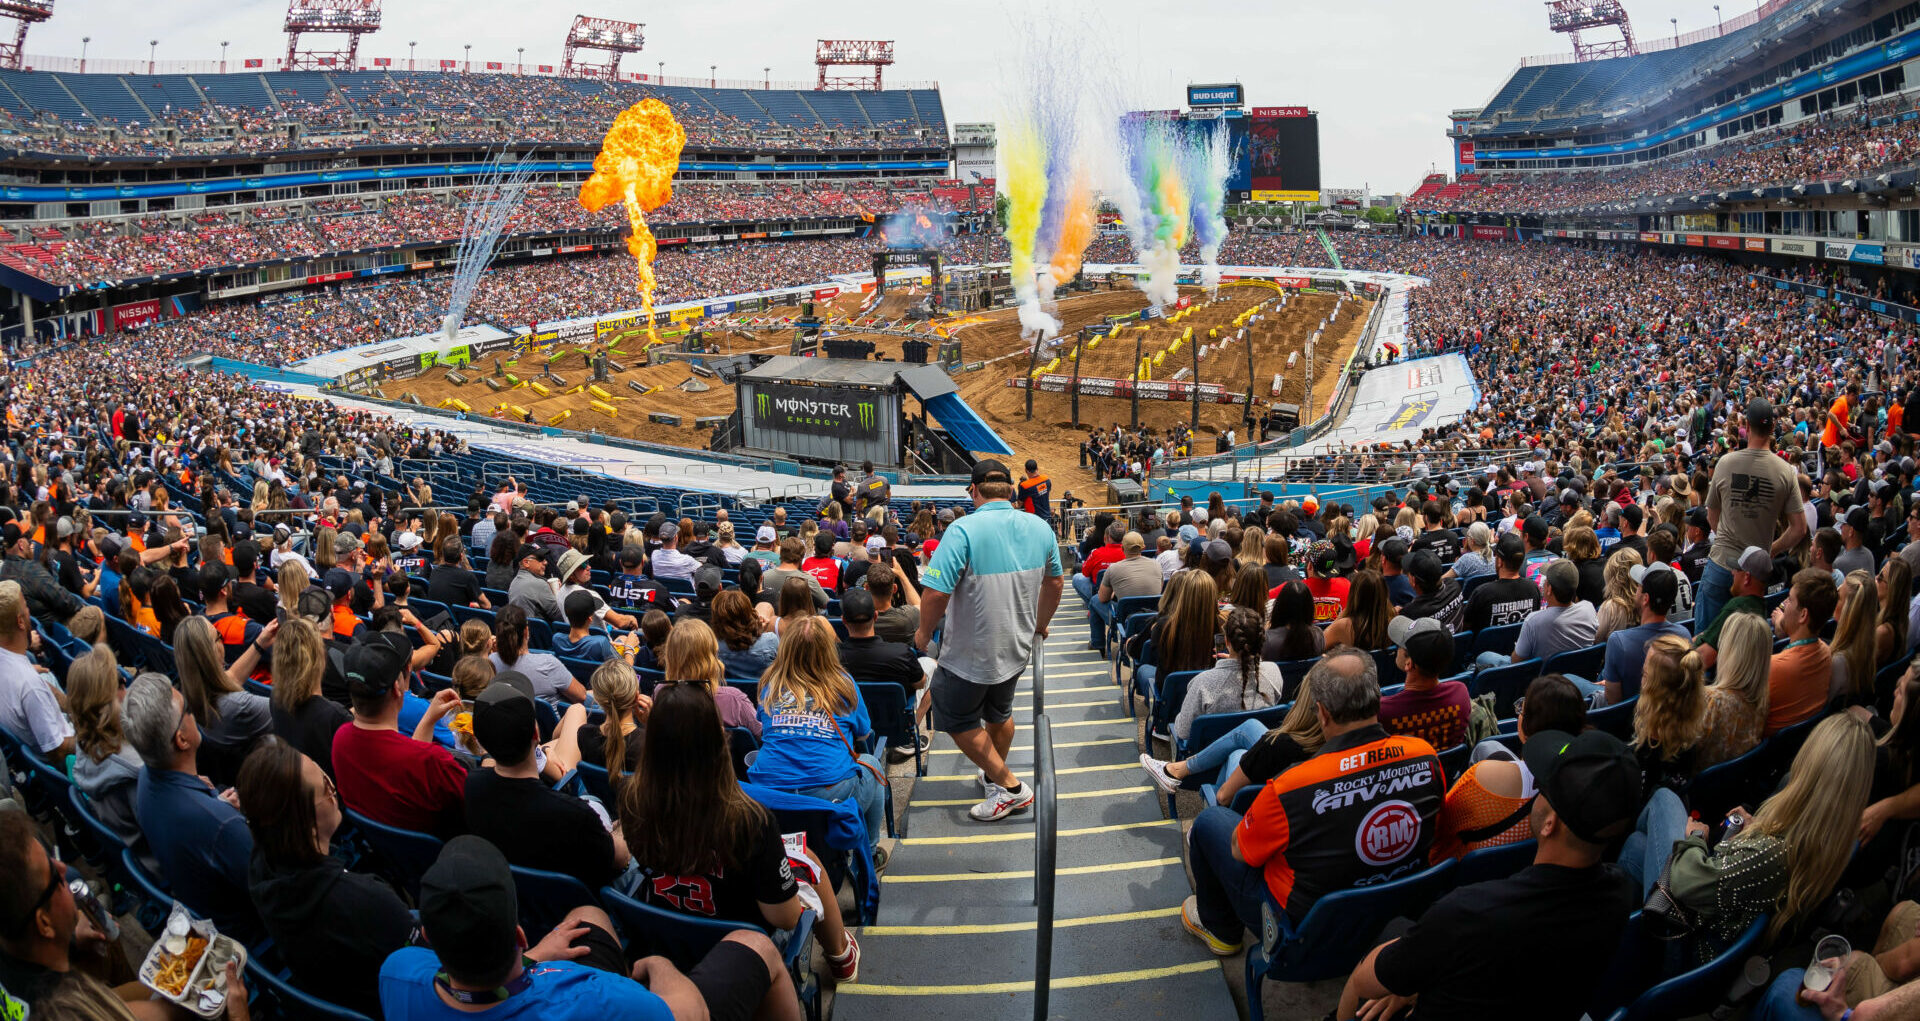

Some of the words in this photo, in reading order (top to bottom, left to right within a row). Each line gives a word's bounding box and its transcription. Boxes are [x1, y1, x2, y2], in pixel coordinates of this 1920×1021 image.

[1193, 92, 1210, 100] BUD
[1210, 91, 1235, 99] LIGHT
[1476, 228, 1503, 236] NISSAN
[889, 253, 918, 263] FINISH
[1826, 243, 1848, 259] Pinnacle
[118, 305, 155, 319] NISSAN
[598, 317, 636, 330] SUZUKI
[775, 397, 852, 418] MONSTER
[787, 416, 840, 427] ENERGY
[609, 585, 657, 603] JUST1
[1491, 599, 1534, 614] BITTERMAN
[1333, 774, 1375, 794] ROCKY
[1377, 760, 1430, 782] MOUNTAIN
[1373, 814, 1414, 850] RM
